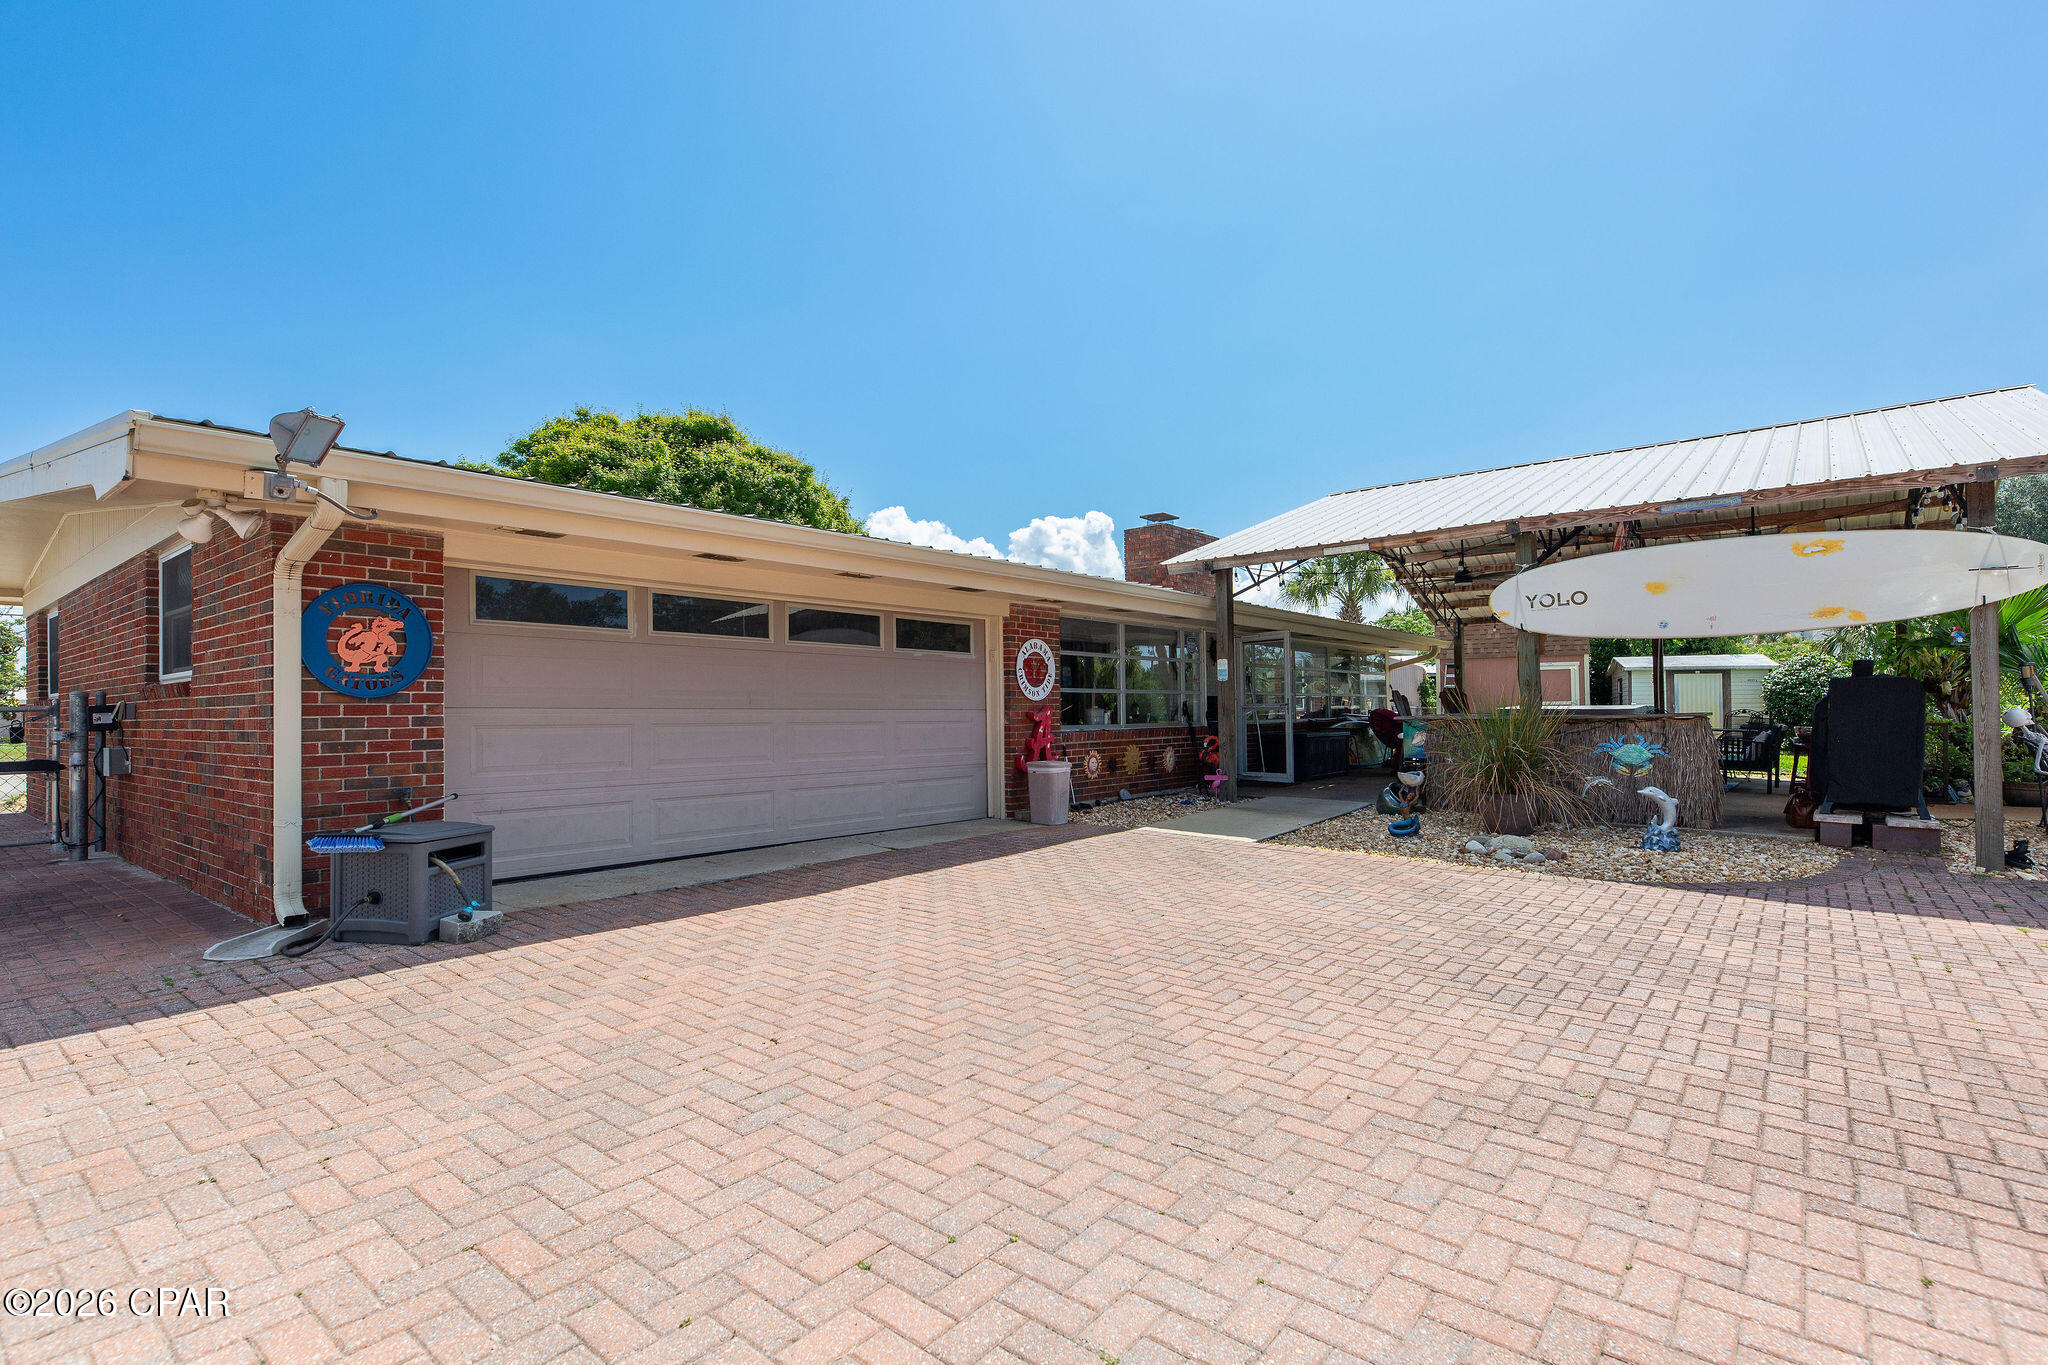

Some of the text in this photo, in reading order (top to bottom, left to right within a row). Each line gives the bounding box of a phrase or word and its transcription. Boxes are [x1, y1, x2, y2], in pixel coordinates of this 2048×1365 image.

[318, 591, 411, 620] FLORIDA
[1525, 590, 1588, 609] YOLO
[1021, 641, 1051, 662] ALABAMA
[325, 667, 404, 690] GATORS
[1018, 667, 1053, 697] CRIMSON TIDE
